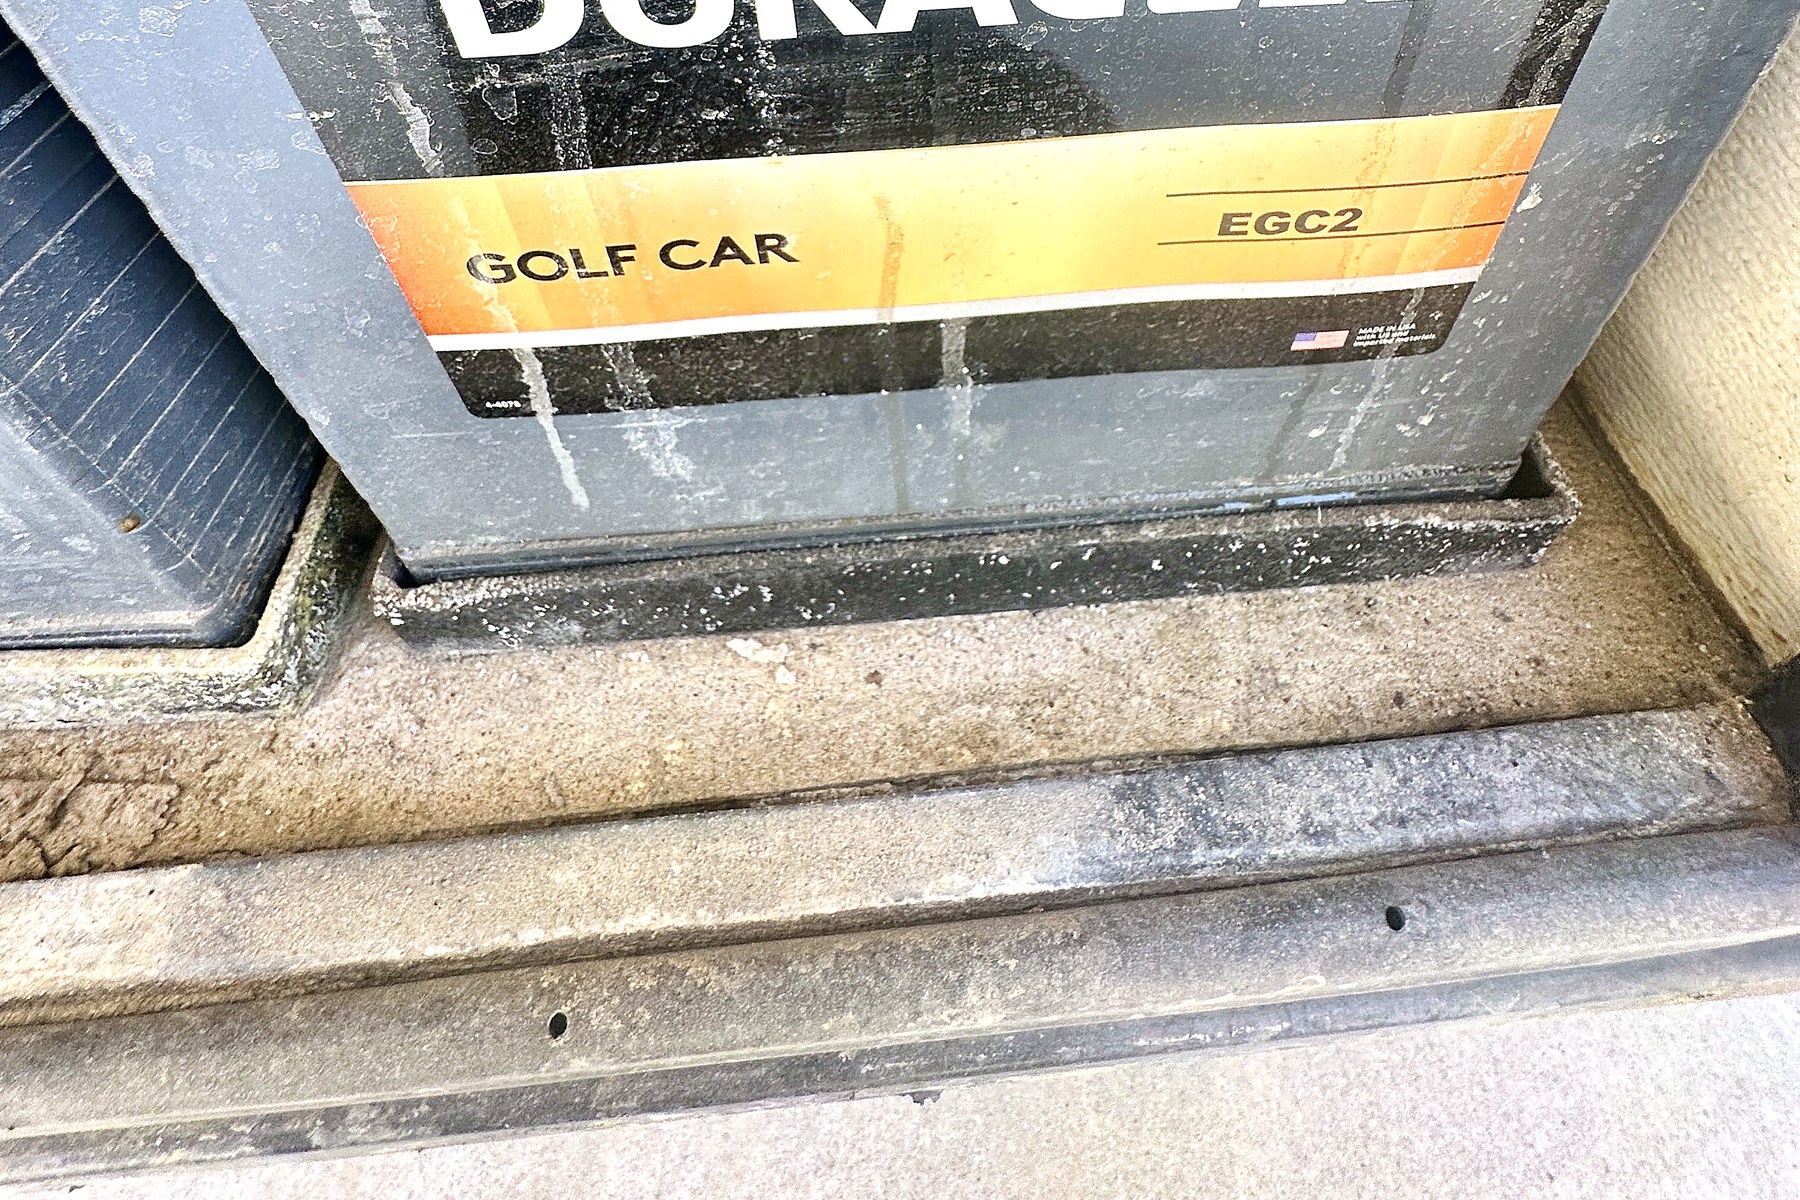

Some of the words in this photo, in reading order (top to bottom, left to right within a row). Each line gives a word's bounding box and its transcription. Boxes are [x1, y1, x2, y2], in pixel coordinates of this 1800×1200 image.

[1218, 207, 1362, 236] EGC2
[466, 244, 637, 284] GOLF
[660, 233, 800, 270] CAR
[1358, 326, 1385, 335] MADE
[1386, 324, 1397, 332] IN
[1398, 323, 1416, 331] USA
